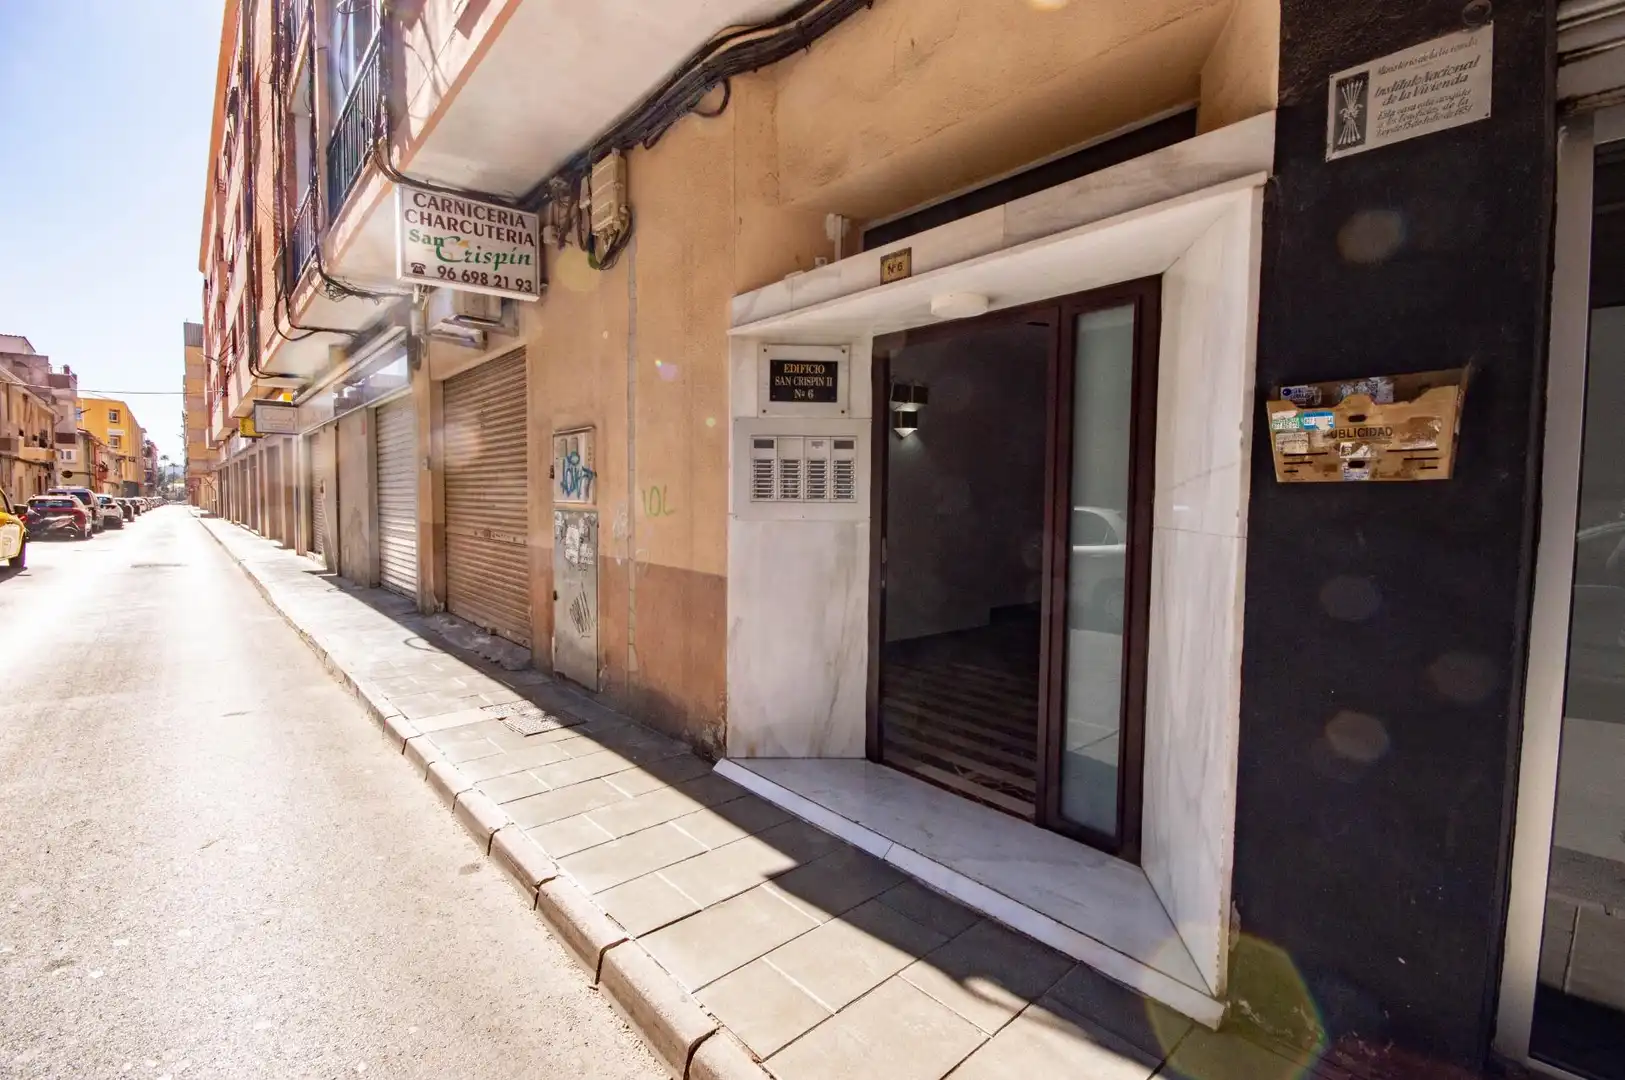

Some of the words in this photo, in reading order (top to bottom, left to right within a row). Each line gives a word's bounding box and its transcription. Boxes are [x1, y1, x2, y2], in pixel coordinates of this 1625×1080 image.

[1413, 74, 1469, 97] Vivienda
[413, 192, 527, 229] CARNICERIA
[405, 208, 535, 247] CHARCUTERIA
[408, 229, 444, 248] San
[897, 262, 904, 271] 6
[437, 265, 456, 281] 96
[461, 269, 488, 287] 698
[493, 275, 509, 289] 21
[515, 278, 533, 293] 93
[783, 363, 825, 374] EDIFICIO
[775, 376, 792, 386] SAN
[827, 377, 833, 387] II
[807, 388, 814, 399] 6
[1327, 426, 1393, 439] UBLICIDAD
